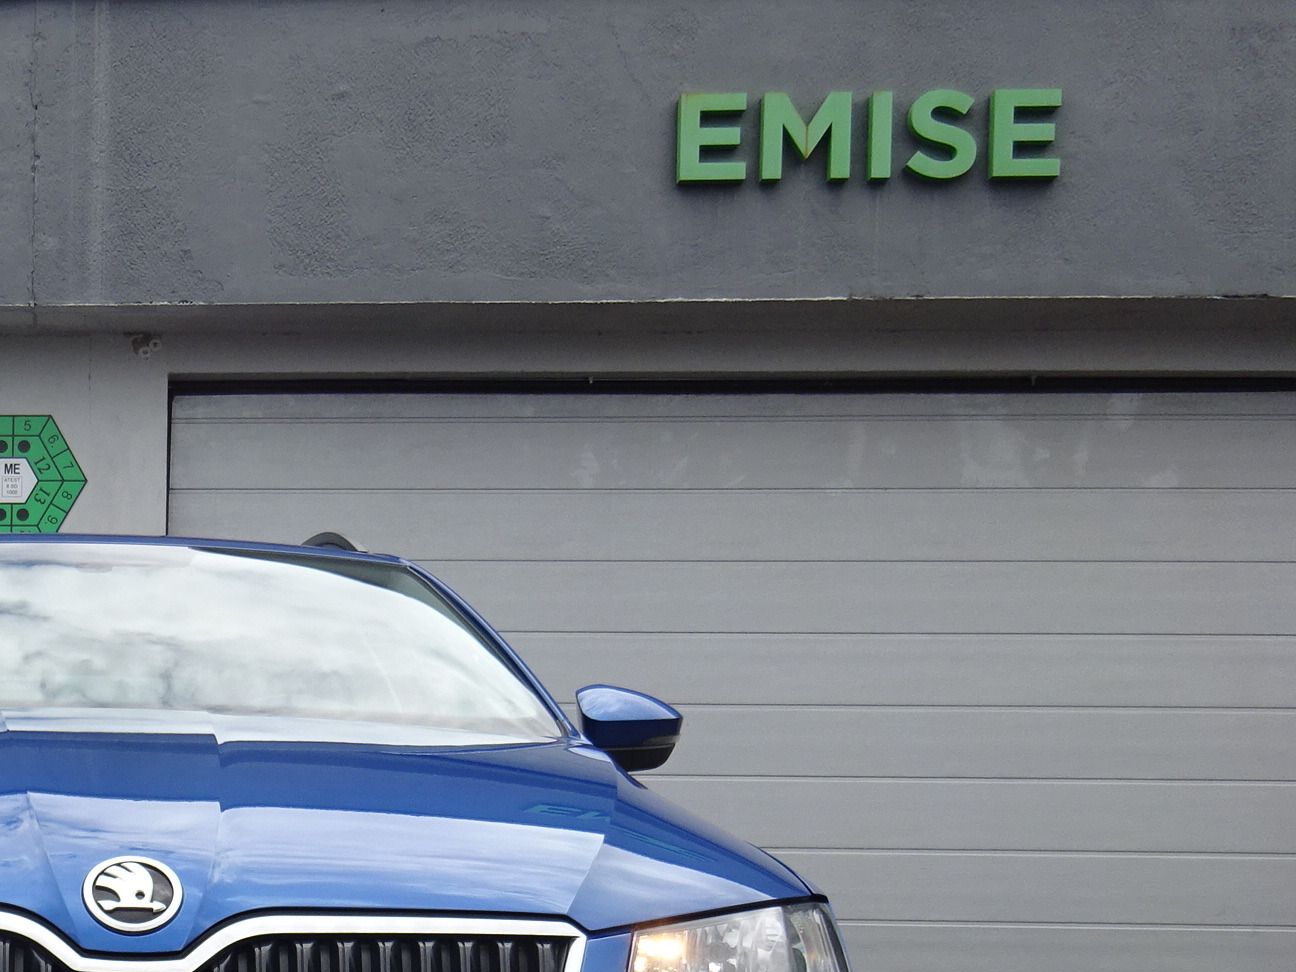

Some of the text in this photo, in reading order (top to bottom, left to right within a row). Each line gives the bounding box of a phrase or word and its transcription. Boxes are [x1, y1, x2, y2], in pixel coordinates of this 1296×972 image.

[676, 89, 1063, 183] EMISE
[23, 420, 32, 432] 5
[4, 463, 21, 475] ME
[33, 455, 51, 475] 12
[62, 461, 74, 470] 7
[33, 487, 51, 505] 13
[62, 490, 73, 500] 8
